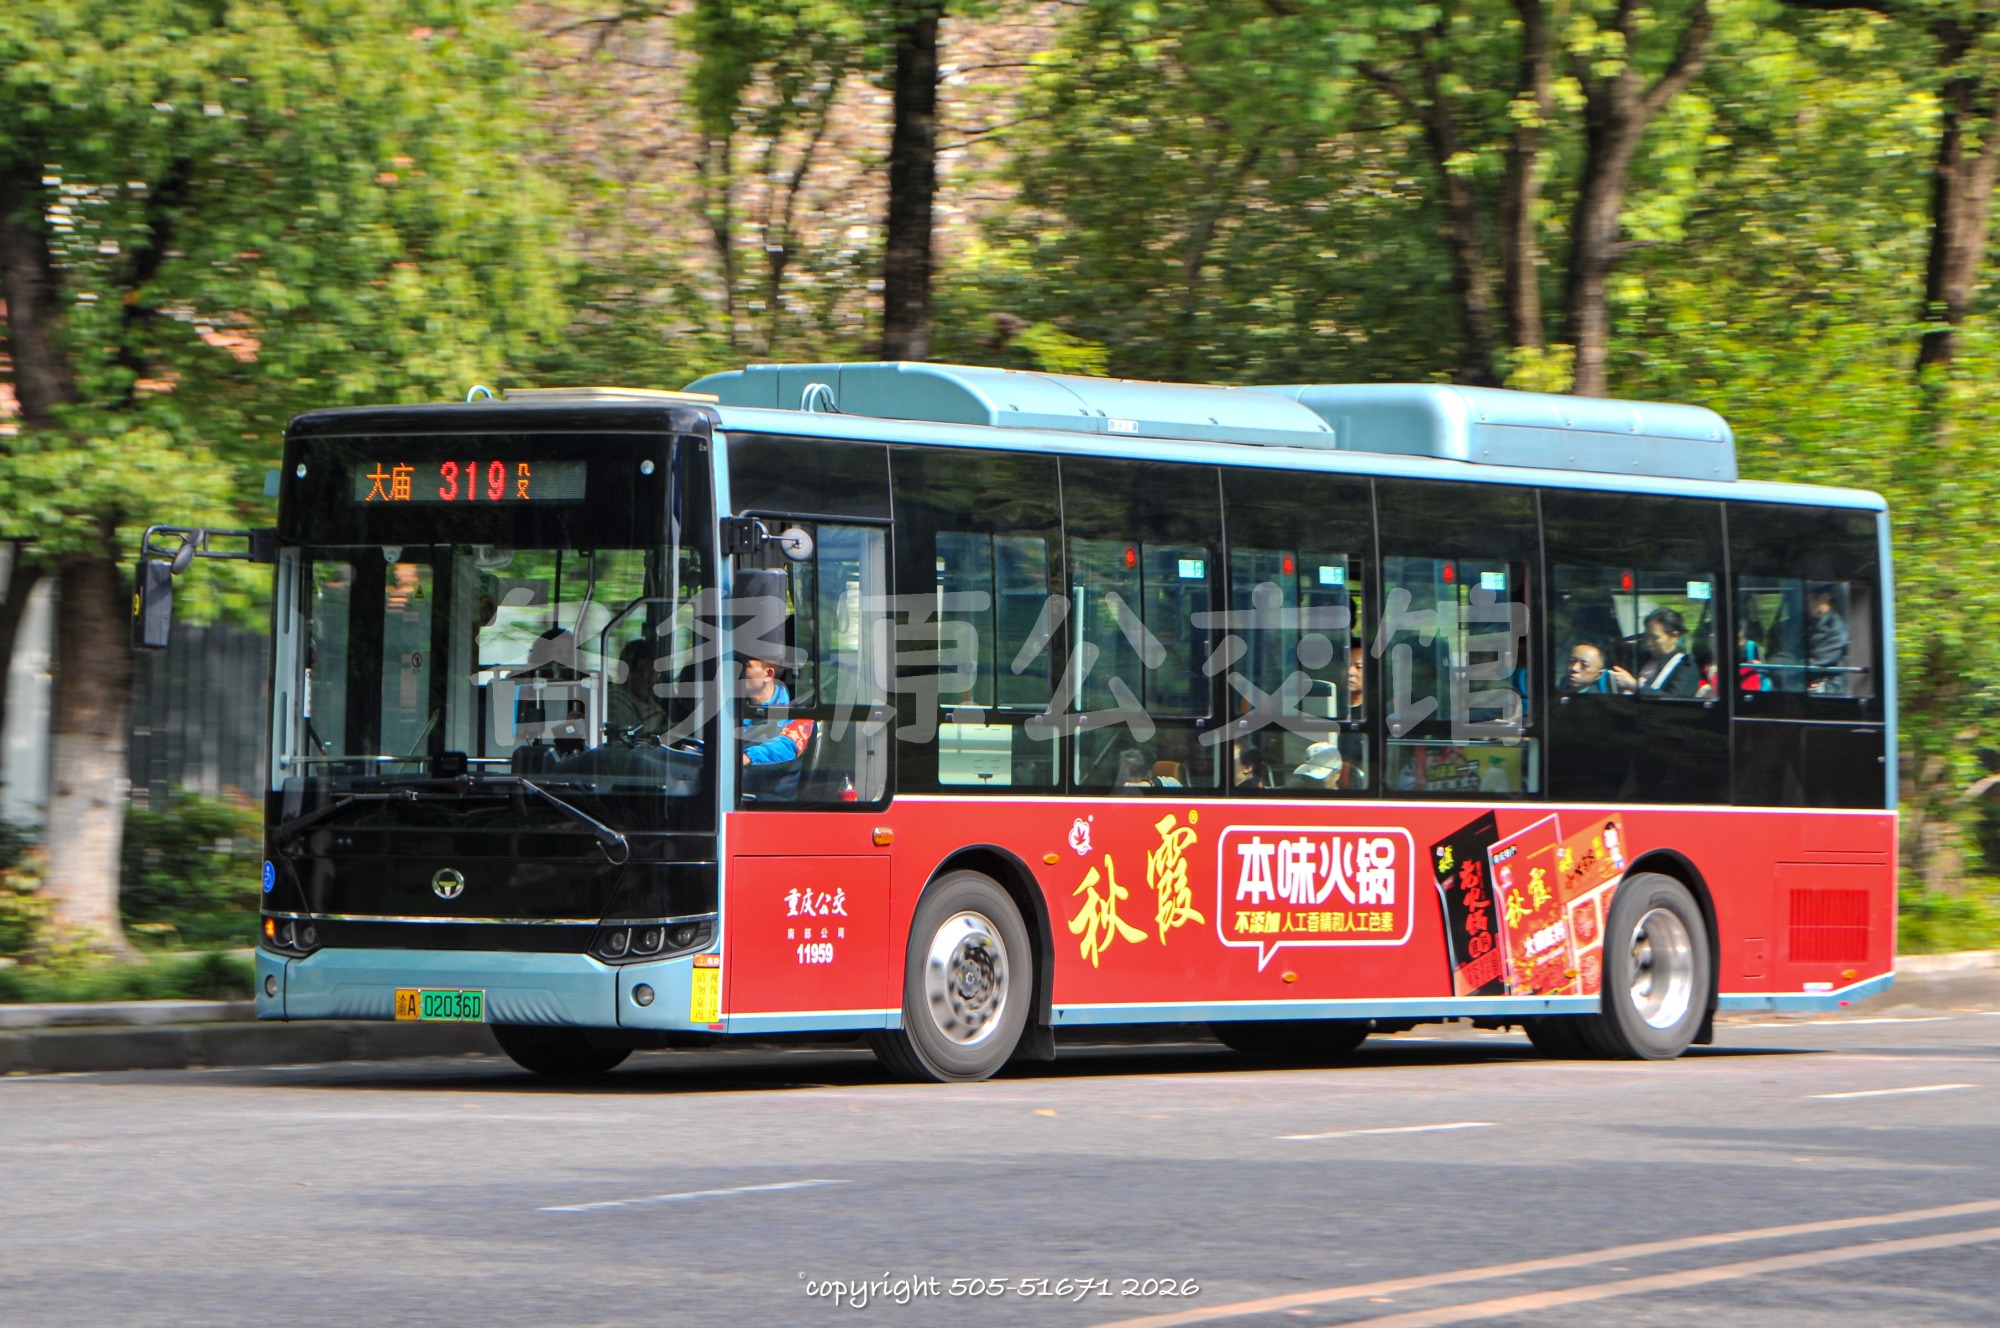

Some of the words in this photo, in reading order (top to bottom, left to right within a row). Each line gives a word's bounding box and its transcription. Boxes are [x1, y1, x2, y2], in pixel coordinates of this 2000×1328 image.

[365, 462, 415, 501] 大庙
[438, 461, 506, 501] 319
[1236, 836, 1396, 905] 本味火锅
[784, 887, 848, 917] 重庆公交
[1068, 813, 1206, 969] 秋霞
[787, 926, 845, 940] 南部公司
[796, 942, 834, 964] 11959
